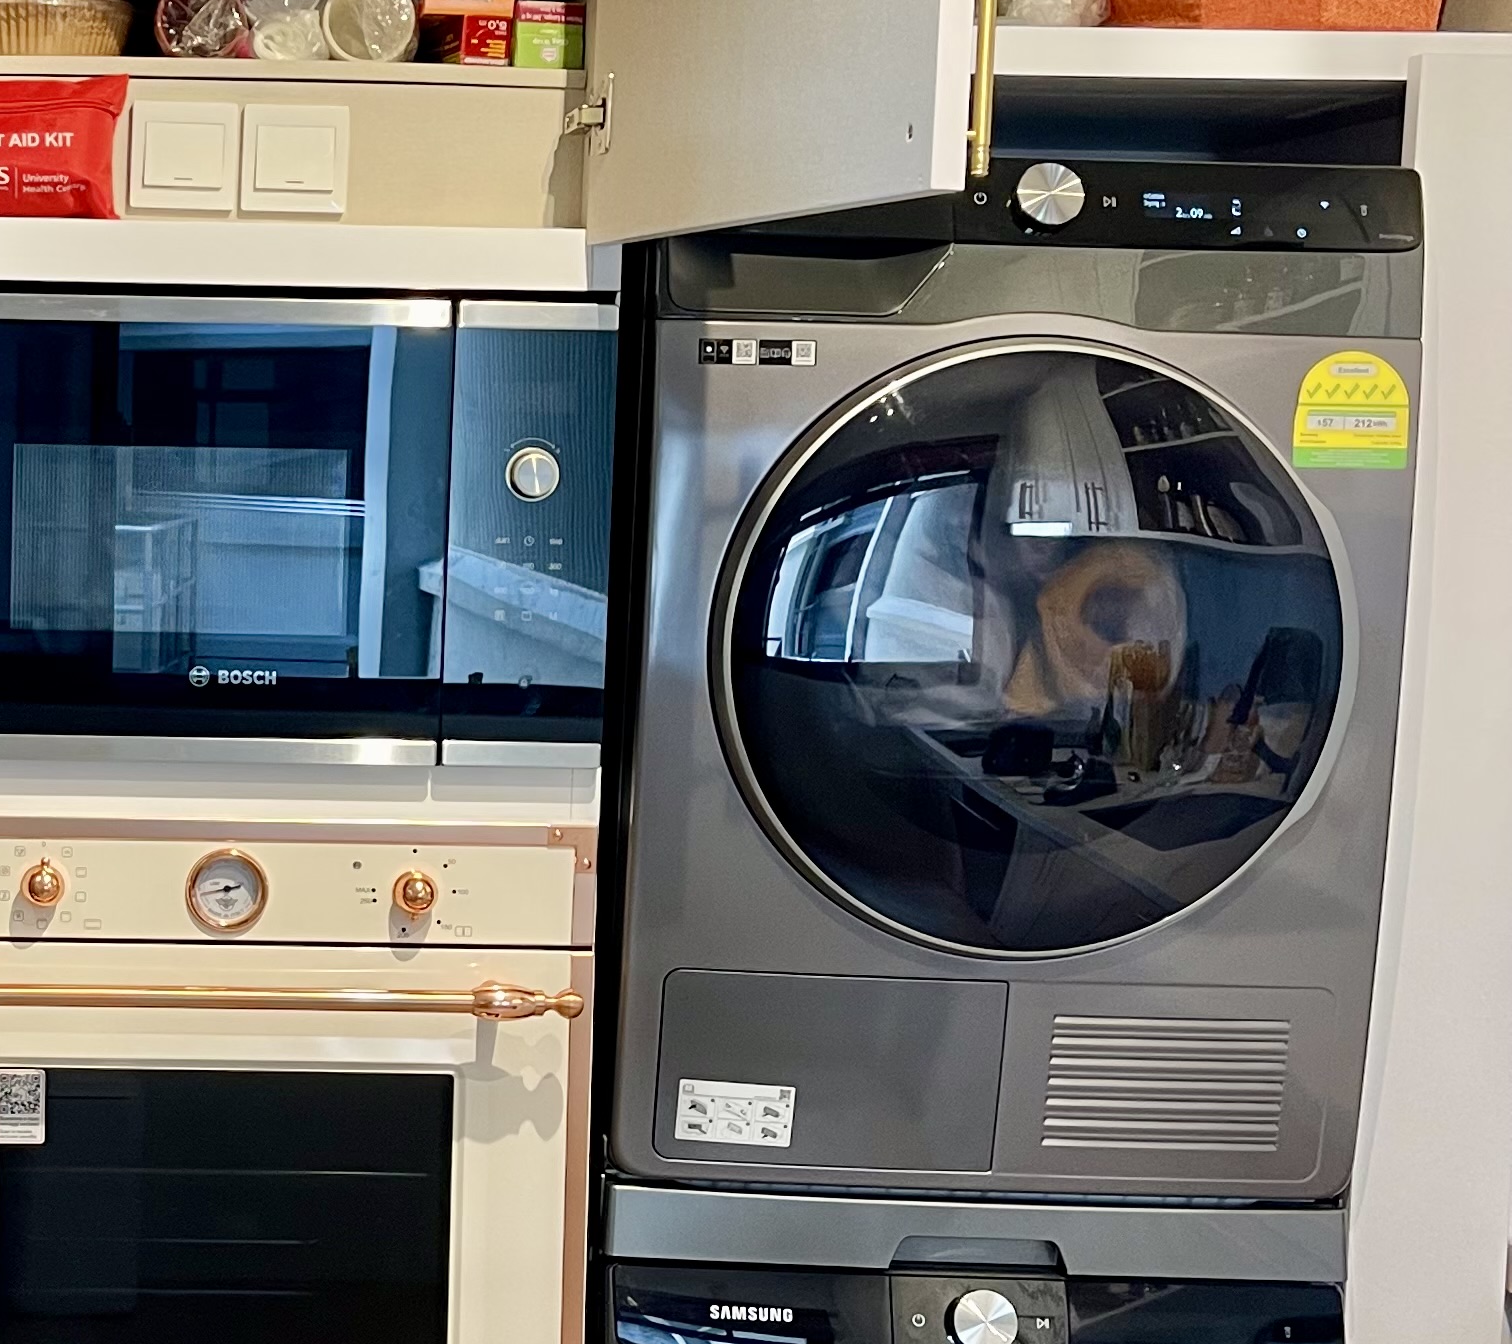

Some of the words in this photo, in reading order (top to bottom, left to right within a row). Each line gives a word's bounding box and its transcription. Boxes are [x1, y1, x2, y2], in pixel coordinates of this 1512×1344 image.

[8, 132, 40, 148] AID
[45, 132, 74, 147] KIT
[22, 173, 69, 184] University
[22, 185, 54, 193] Health
[217, 669, 277, 686] BOSCH
[709, 1304, 793, 1323] SAMSUNG
